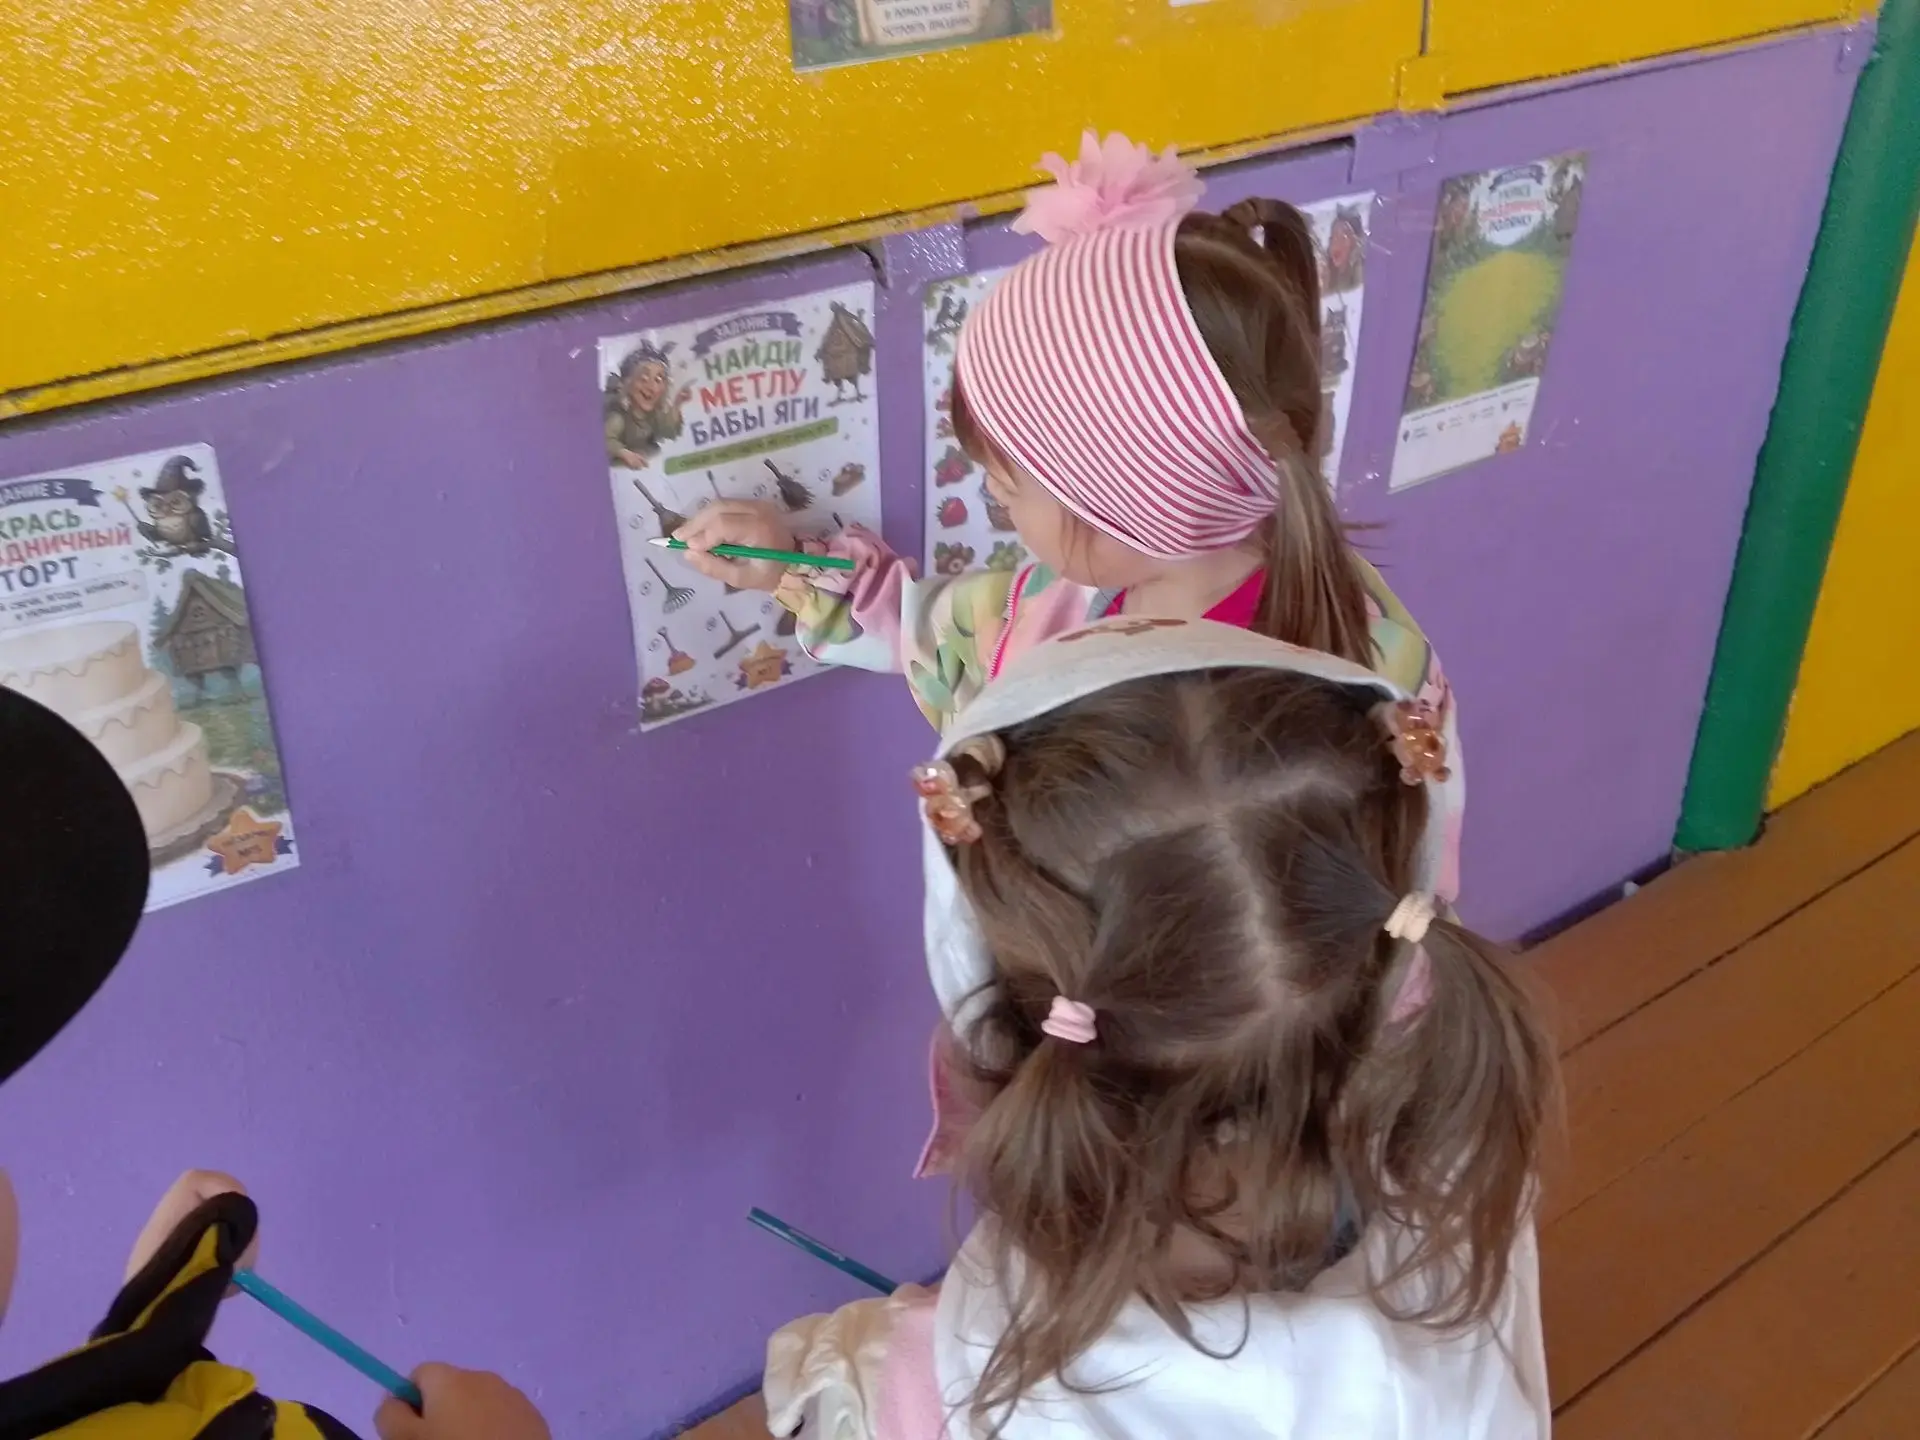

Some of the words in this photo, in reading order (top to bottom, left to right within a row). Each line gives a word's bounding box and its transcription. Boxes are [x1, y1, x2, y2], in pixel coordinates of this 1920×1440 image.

[714, 315, 771, 340] ЗАДАНИЕ
[704, 340, 802, 379] НАЙДИ
[700, 369, 806, 413] МЕТЛУ
[691, 407, 764, 446] БАБЫ
[774, 397, 819, 426] ЯГИ
[0, 482, 50, 504] АНИЕ
[54, 481, 66, 496] 5
[0, 522, 132, 567] ДНИЧНЫЙ
[0, 556, 79, 592] ТОРТ
